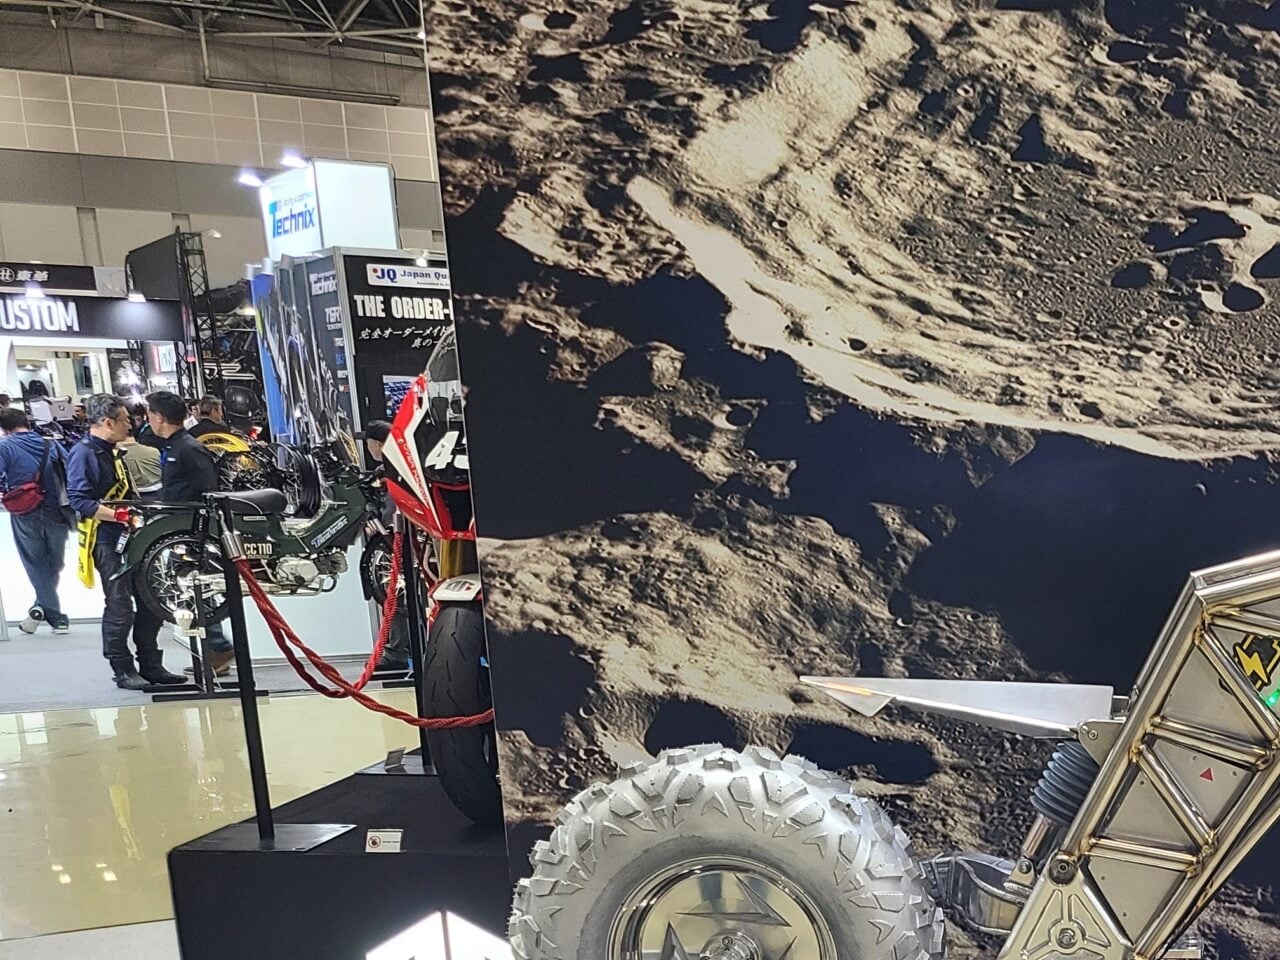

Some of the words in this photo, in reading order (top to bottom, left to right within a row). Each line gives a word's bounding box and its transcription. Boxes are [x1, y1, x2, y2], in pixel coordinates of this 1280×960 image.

[376, 268, 397, 283] JQ
[400, 270, 431, 279] Japan
[353, 295, 386, 318] THE
